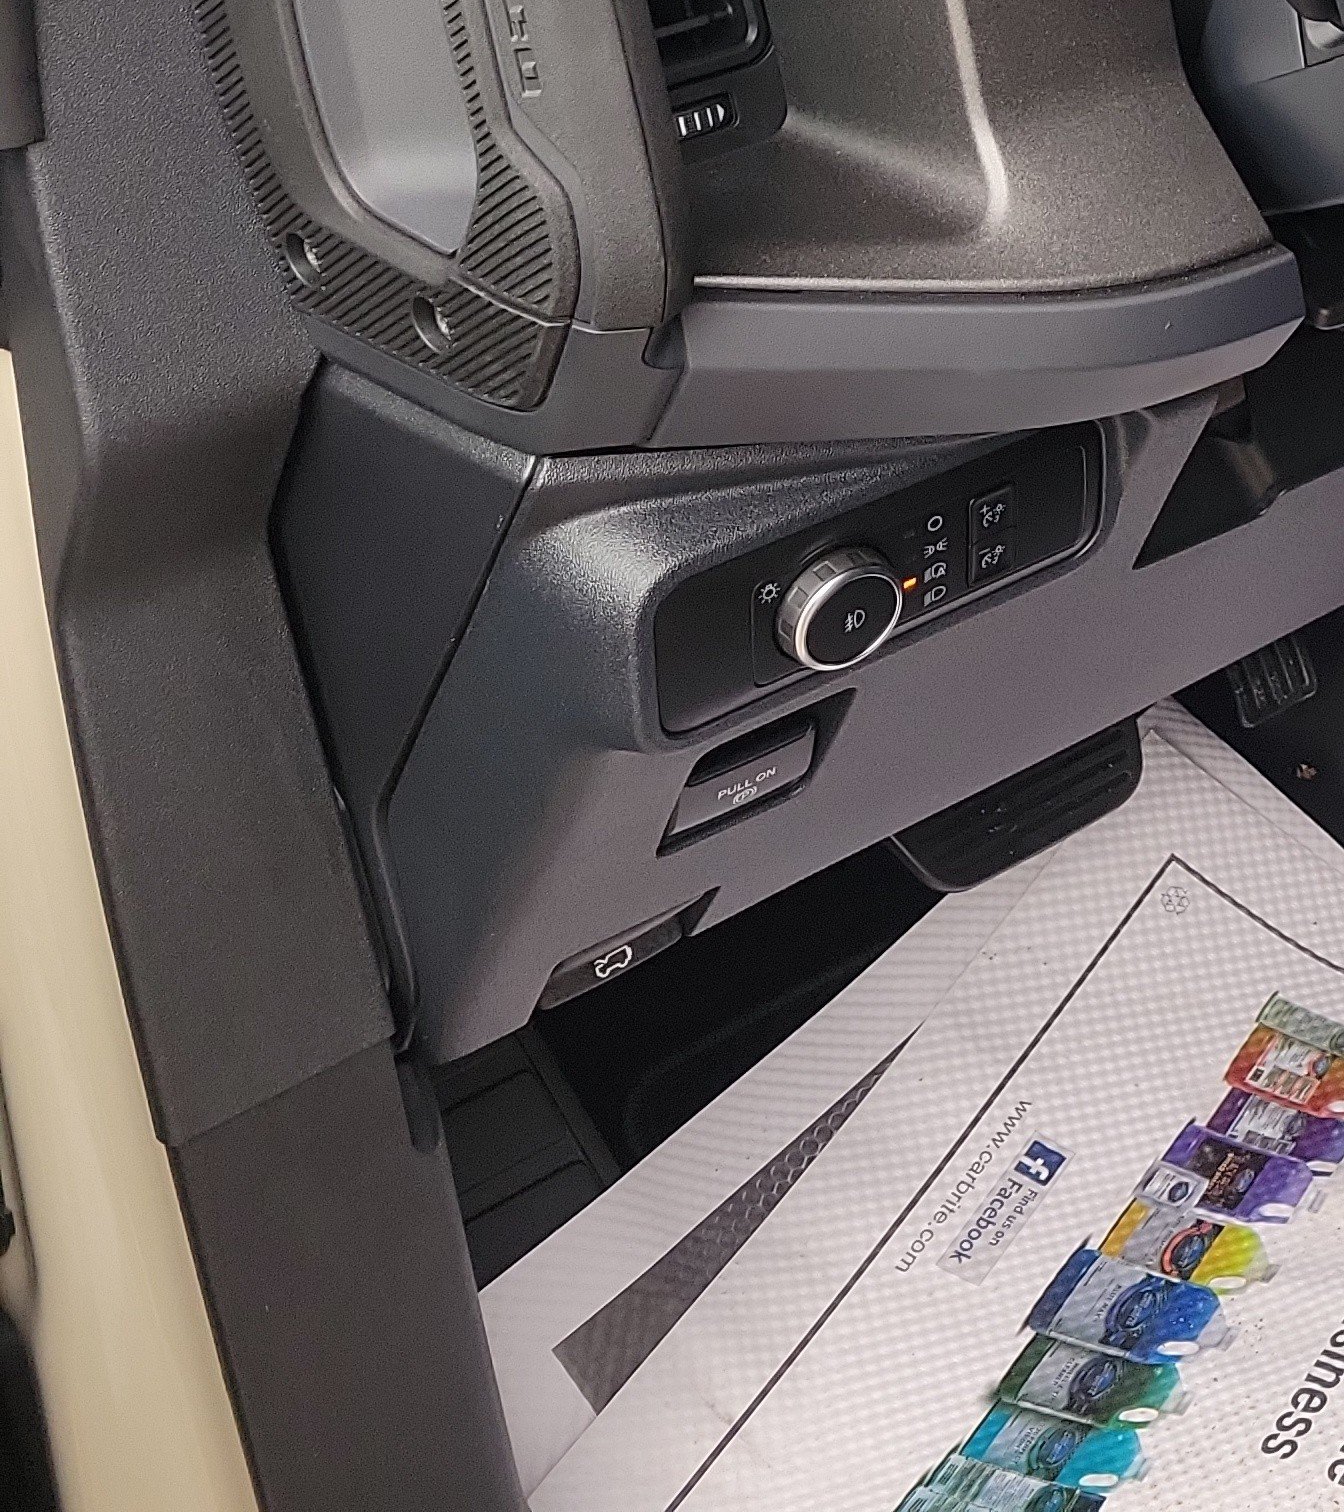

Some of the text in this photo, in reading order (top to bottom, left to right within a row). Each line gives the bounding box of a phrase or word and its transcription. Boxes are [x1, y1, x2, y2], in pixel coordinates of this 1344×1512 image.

[717, 766, 777, 800] PULL ON
[894, 1100, 1033, 1274] www.carbrite.com
[948, 1177, 1024, 1264] Facebook
[988, 1188, 1039, 1247] Find us on
